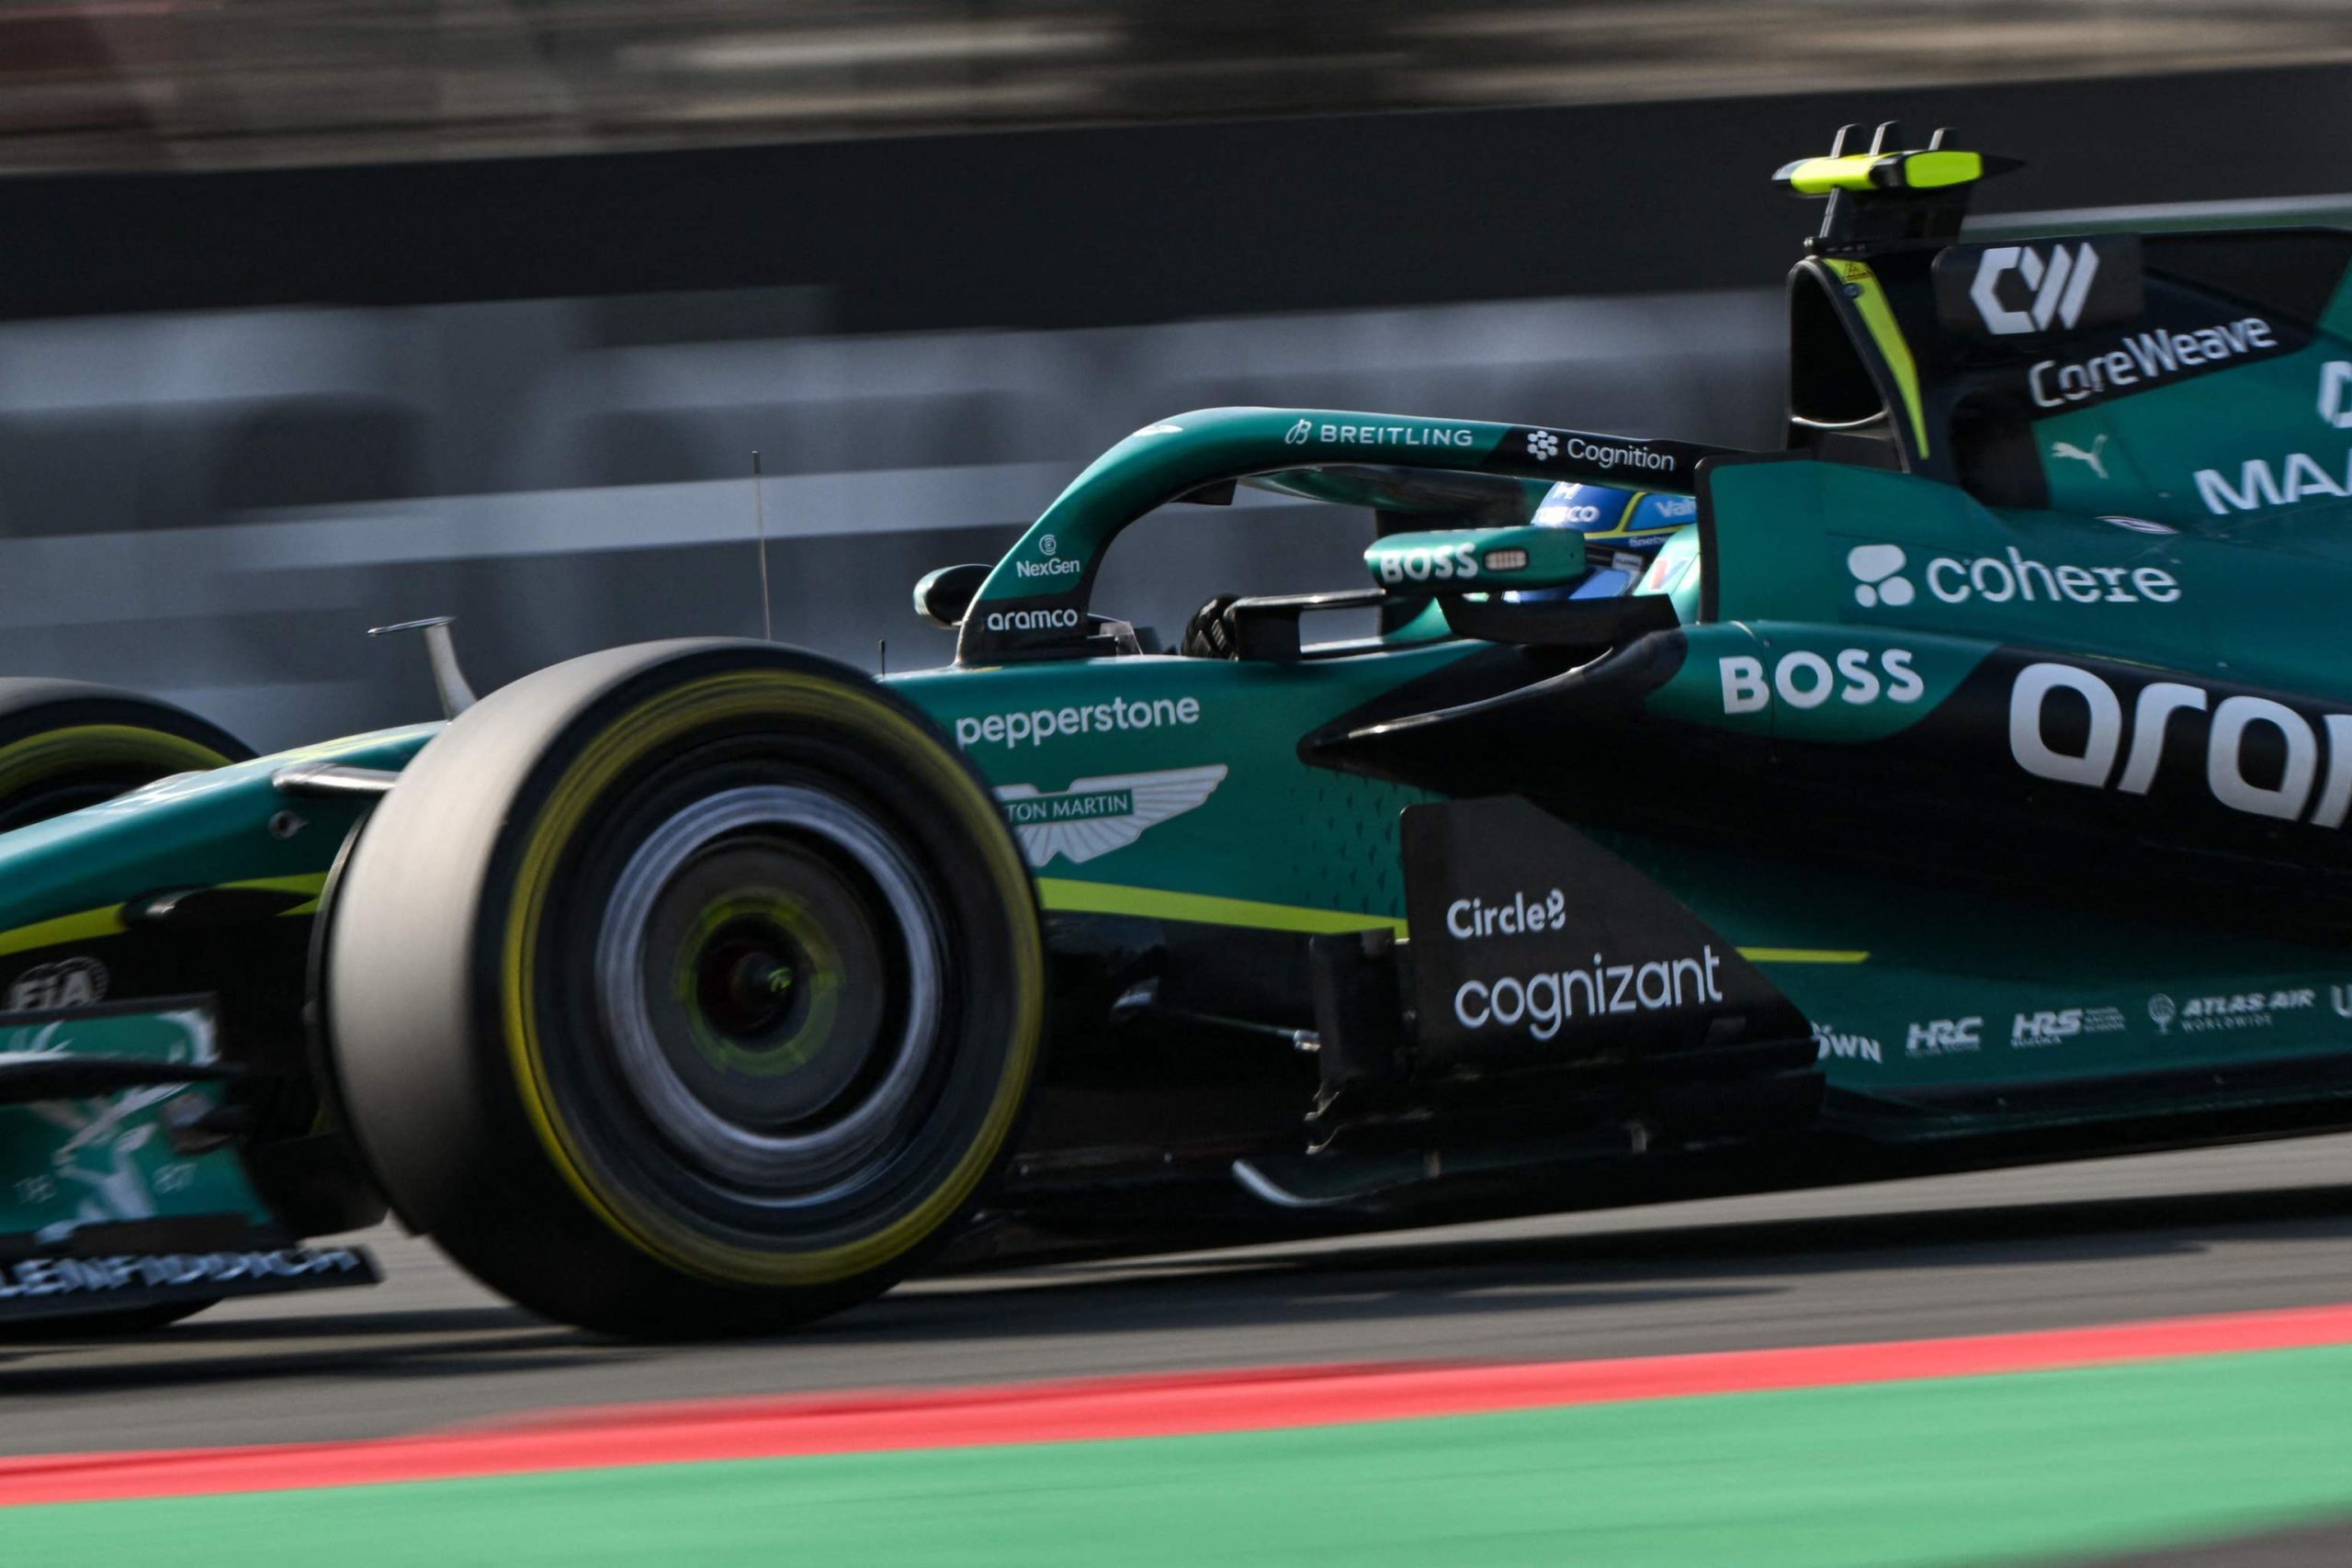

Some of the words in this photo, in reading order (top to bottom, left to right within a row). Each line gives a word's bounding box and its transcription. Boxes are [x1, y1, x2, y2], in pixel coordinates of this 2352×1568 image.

[2029, 317, 2278, 408] CoreWeave
[1320, 424, 1475, 447] BREITLING
[1566, 437, 1677, 472] Cognition
[2194, 448, 2352, 514] MA
[1016, 557, 1080, 579] NexGen
[1381, 543, 1479, 584] BOSS
[1926, 546, 2181, 604] cohere
[987, 608, 1079, 632] aramco
[1719, 648, 1925, 715] BOSS
[956, 696, 1201, 750] pepperstone
[1005, 800, 1047, 822] TON
[1053, 794, 1129, 817] MARTIN
[1454, 944, 1724, 1042] cognizant
[2182, 993, 2267, 1018] ATLAS
[2267, 988, 2317, 1010] AIR
[1905, 1016, 1984, 1051] HRC
[2012, 1009, 2084, 1039] HRS
